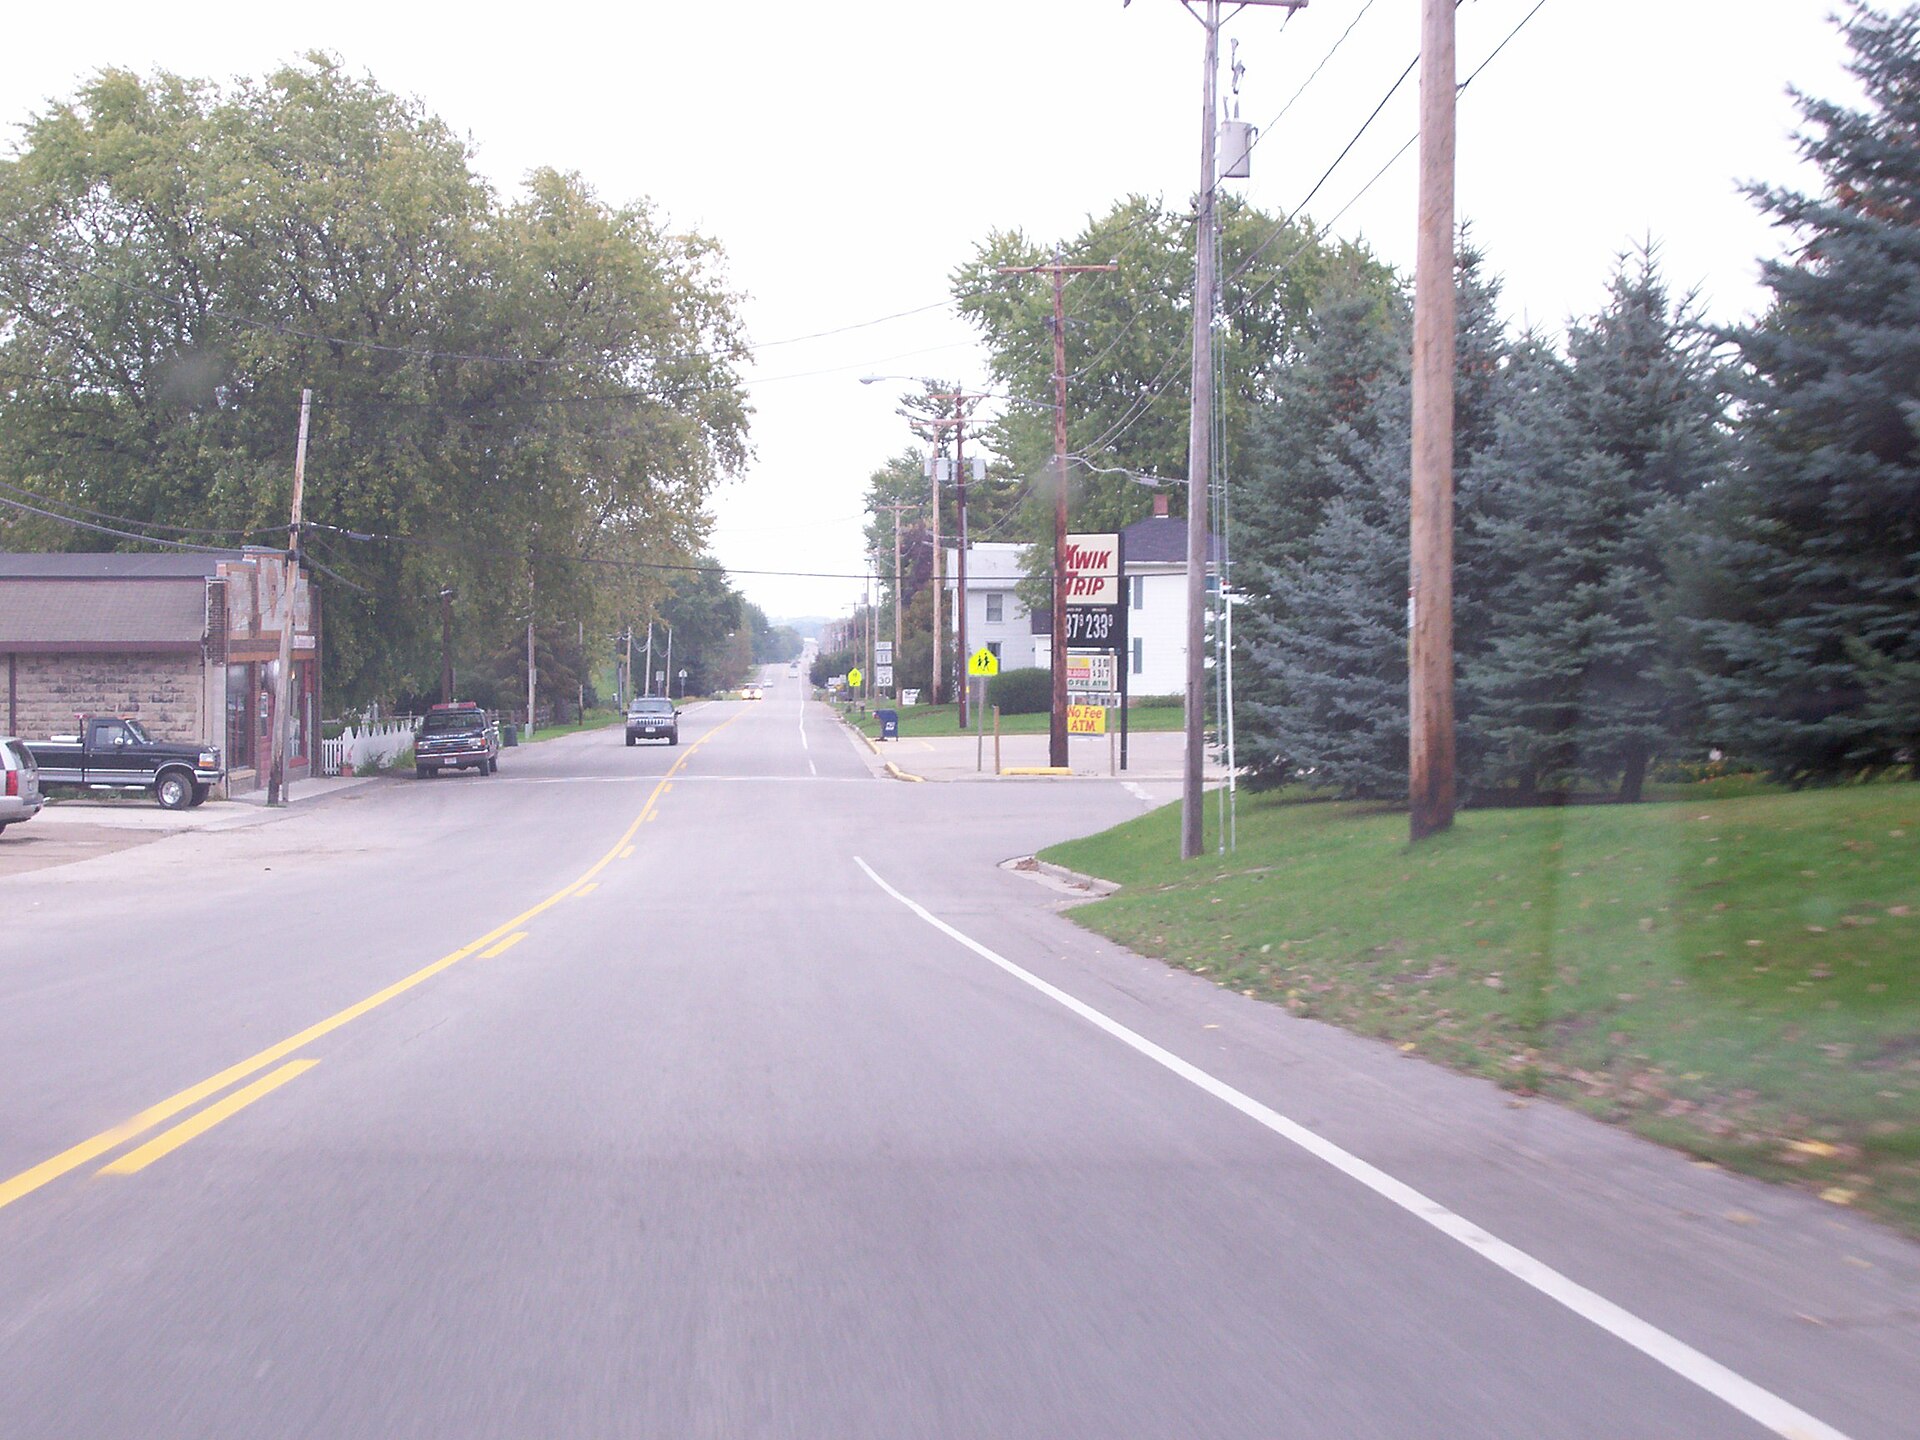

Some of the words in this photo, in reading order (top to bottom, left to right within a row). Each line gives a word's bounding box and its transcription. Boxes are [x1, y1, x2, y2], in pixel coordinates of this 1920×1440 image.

[1065, 544, 1111, 569] KWIK
[1065, 571, 1105, 595] TRIP
[878, 676, 891, 685] 30
[1083, 706, 1102, 719] Fee
[1071, 719, 1096, 732] ATM
